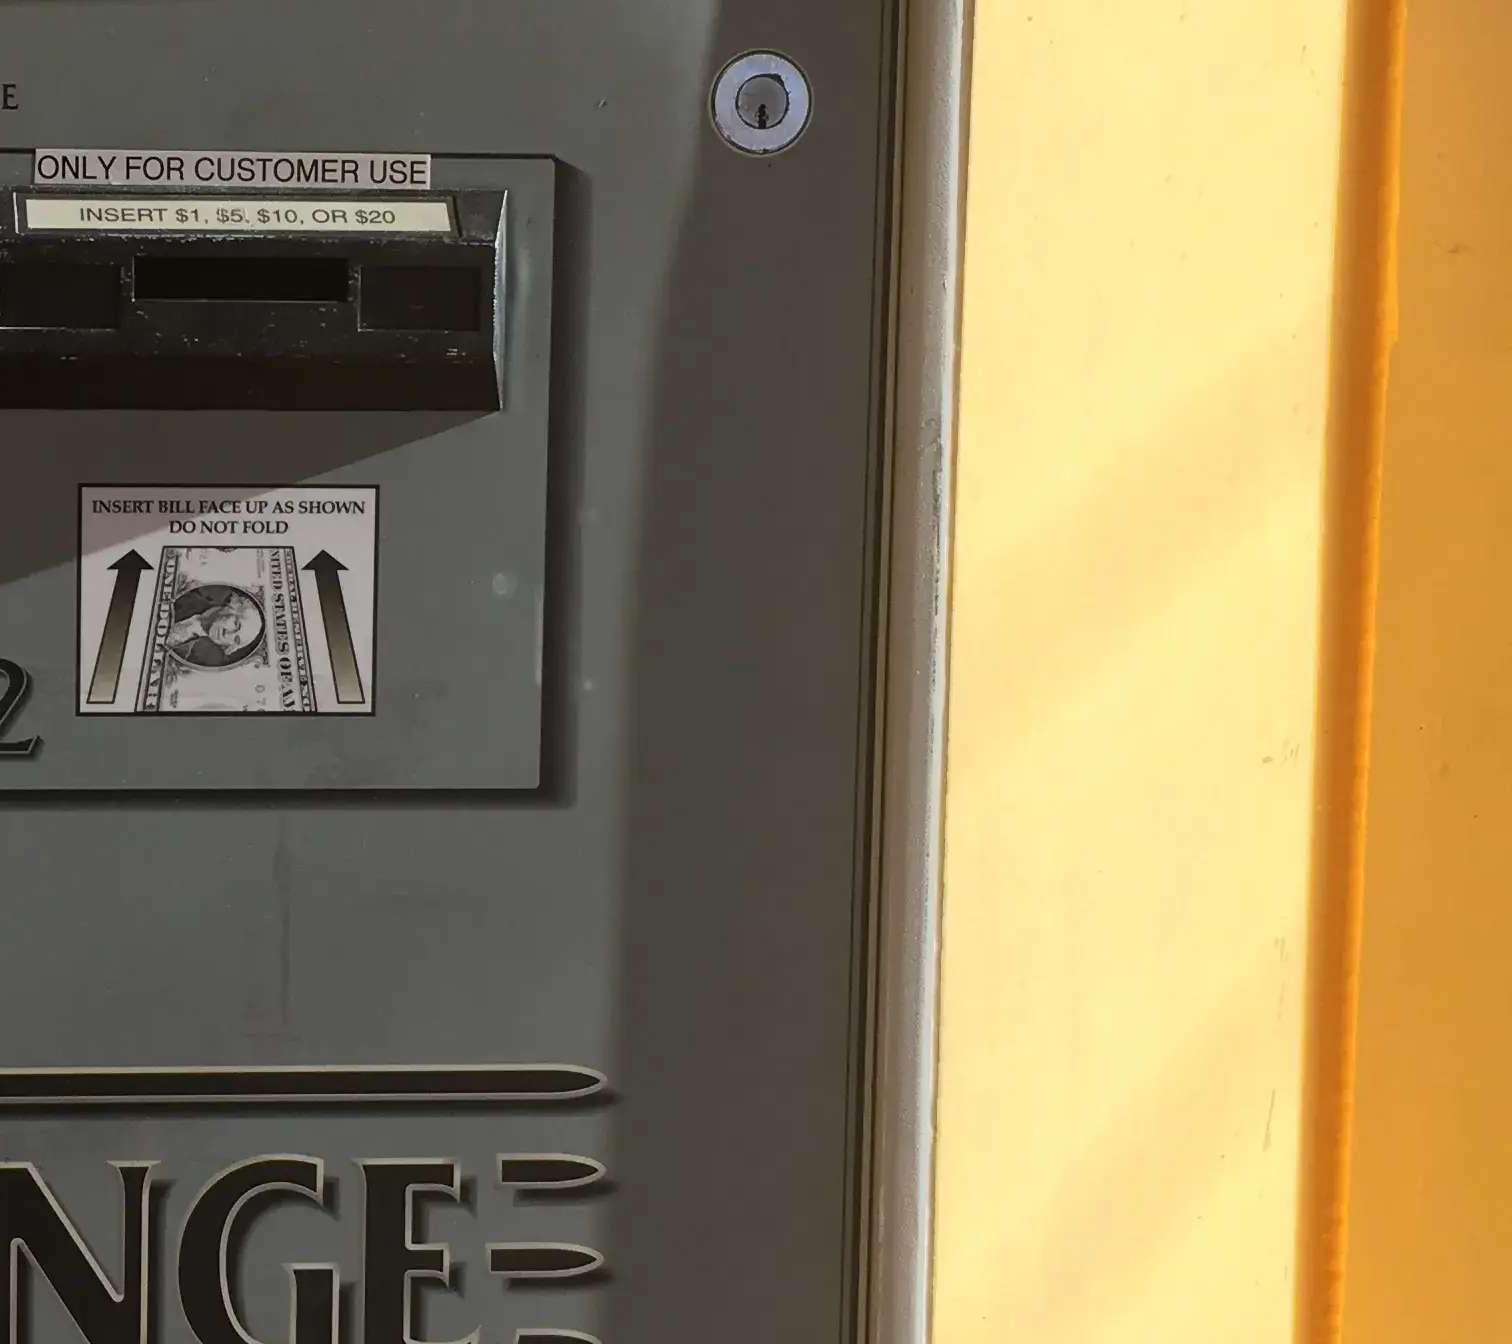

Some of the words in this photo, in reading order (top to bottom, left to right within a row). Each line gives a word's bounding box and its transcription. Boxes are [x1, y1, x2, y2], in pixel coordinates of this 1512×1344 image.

[37, 155, 116, 182] ONLY
[125, 157, 185, 182] FOR
[194, 158, 358, 184] CUSTOMER
[369, 160, 426, 185] USE
[80, 208, 167, 223] INSERT
[175, 207, 209, 226] $1,
[216, 207, 249, 226] $5,
[257, 208, 305, 227] $10,
[312, 209, 348, 224] OR
[355, 209, 396, 226] $20
[92, 500, 154, 514] INSERT
[158, 500, 196, 514] BILL
[199, 500, 242, 514] FACE
[245, 500, 268, 514] UP
[272, 500, 295, 514] AS
[298, 500, 365, 515] SHOWN
[169, 520, 197, 534] DO
[200, 520, 239, 534] NOT
[242, 520, 289, 534] FOLD
[269, 548, 284, 594] NITED
